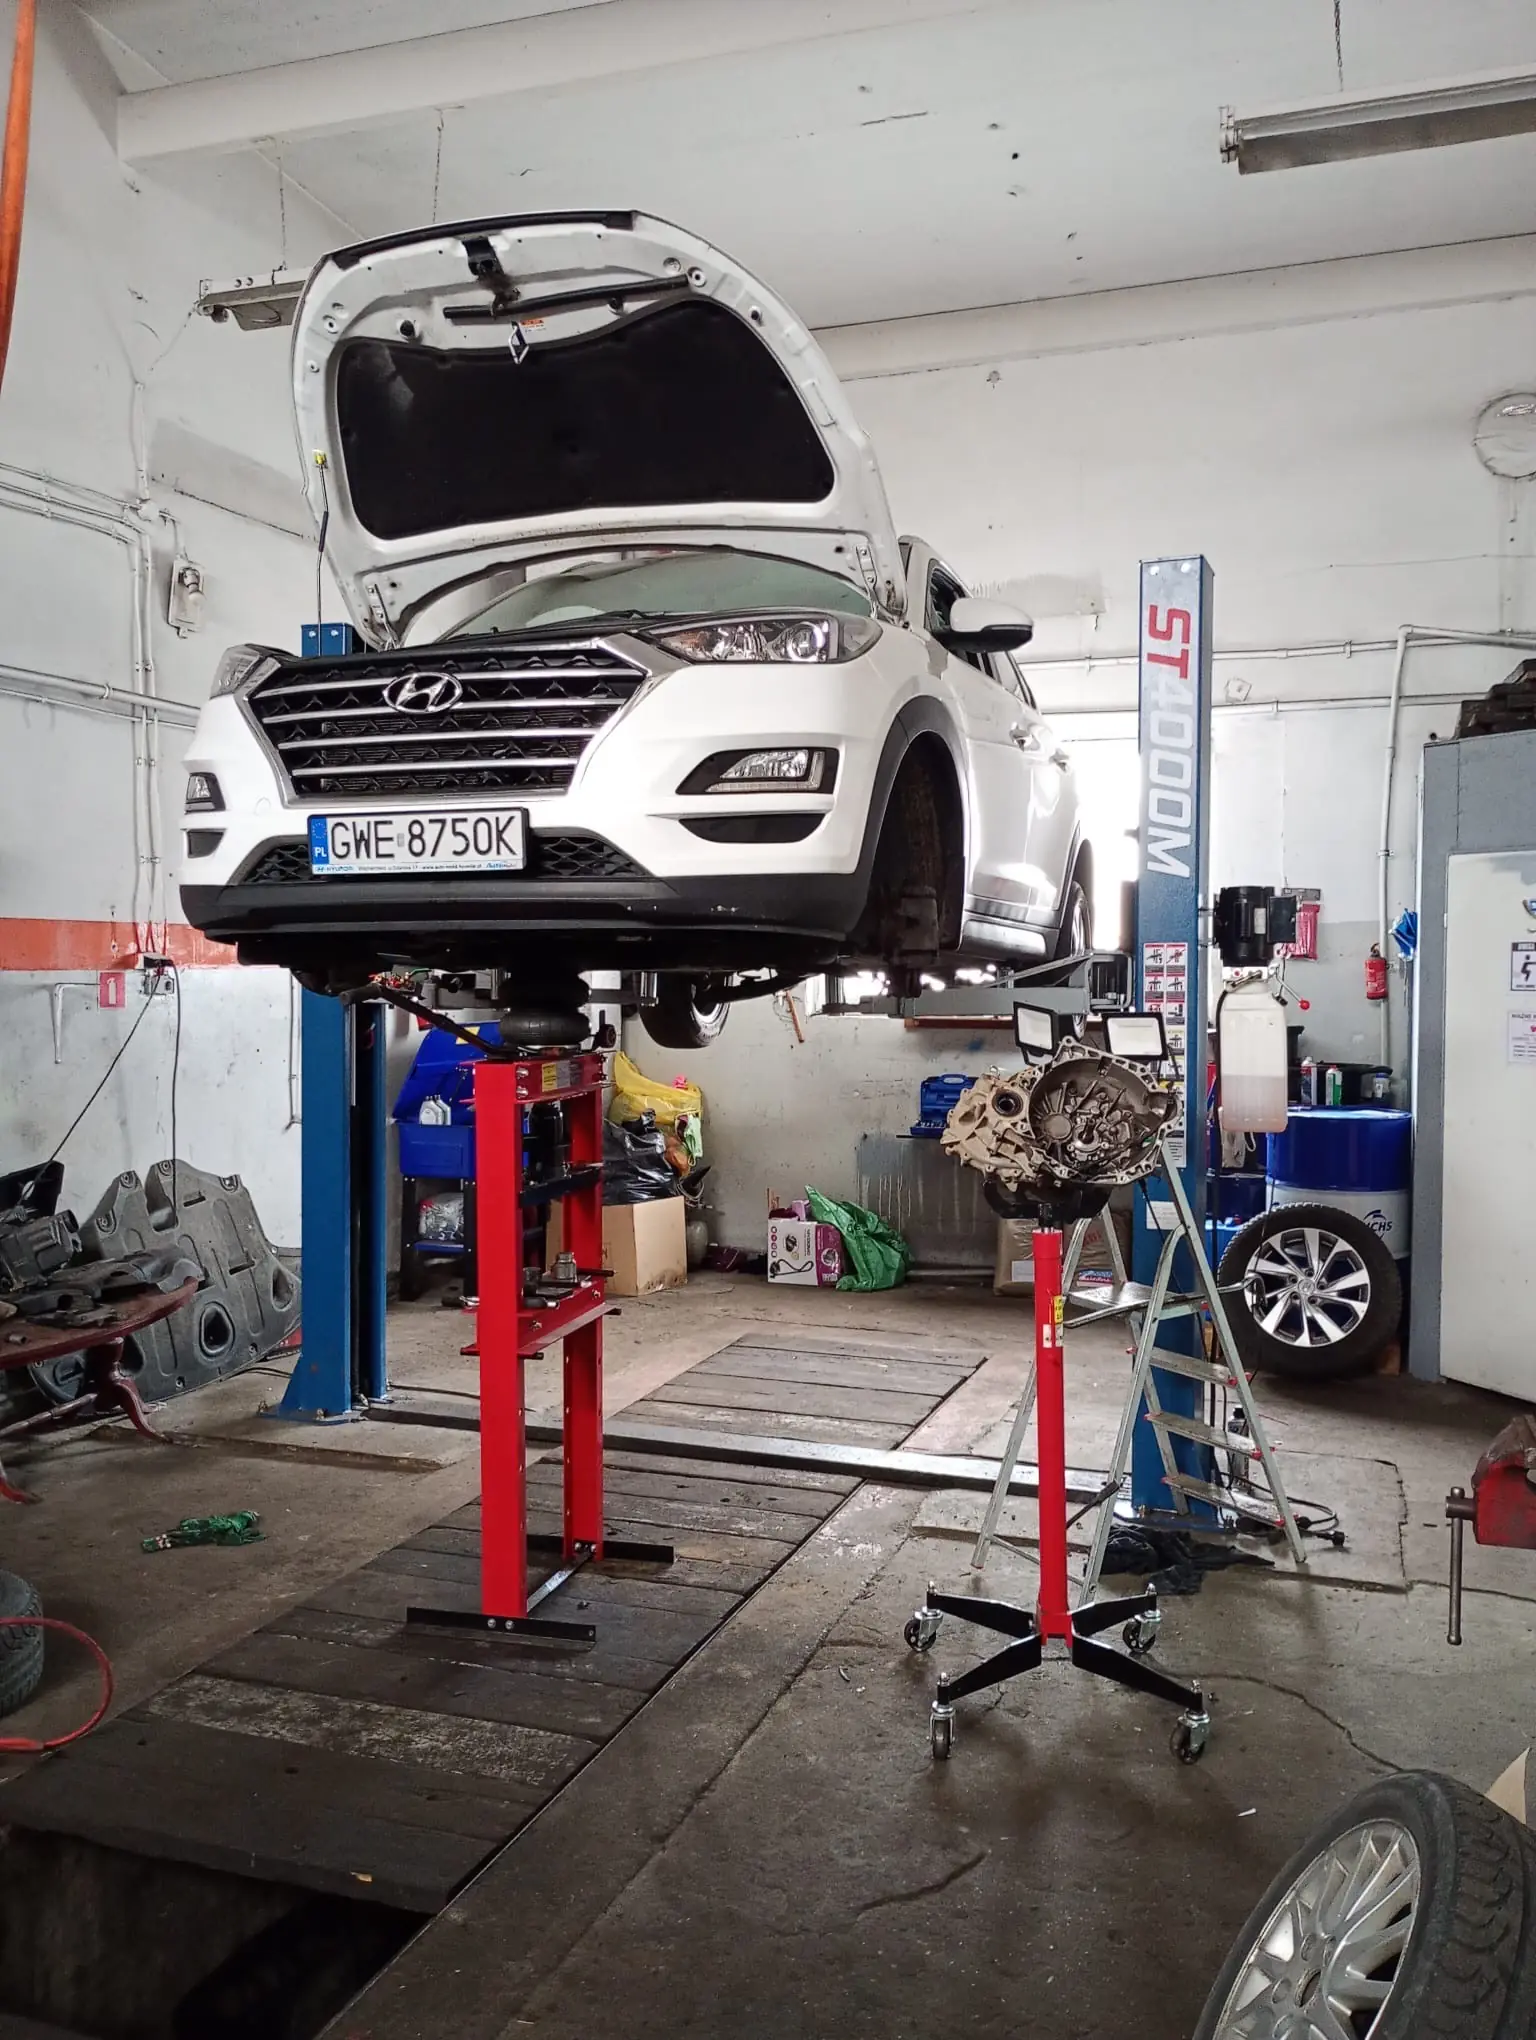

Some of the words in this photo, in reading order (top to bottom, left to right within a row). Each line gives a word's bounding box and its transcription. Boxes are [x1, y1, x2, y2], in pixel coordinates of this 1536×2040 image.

[1146, 604, 1194, 879] ST4000M
[314, 846, 328, 858] PL
[331, 820, 395, 860] GWE
[407, 815, 518, 858] 8750K
